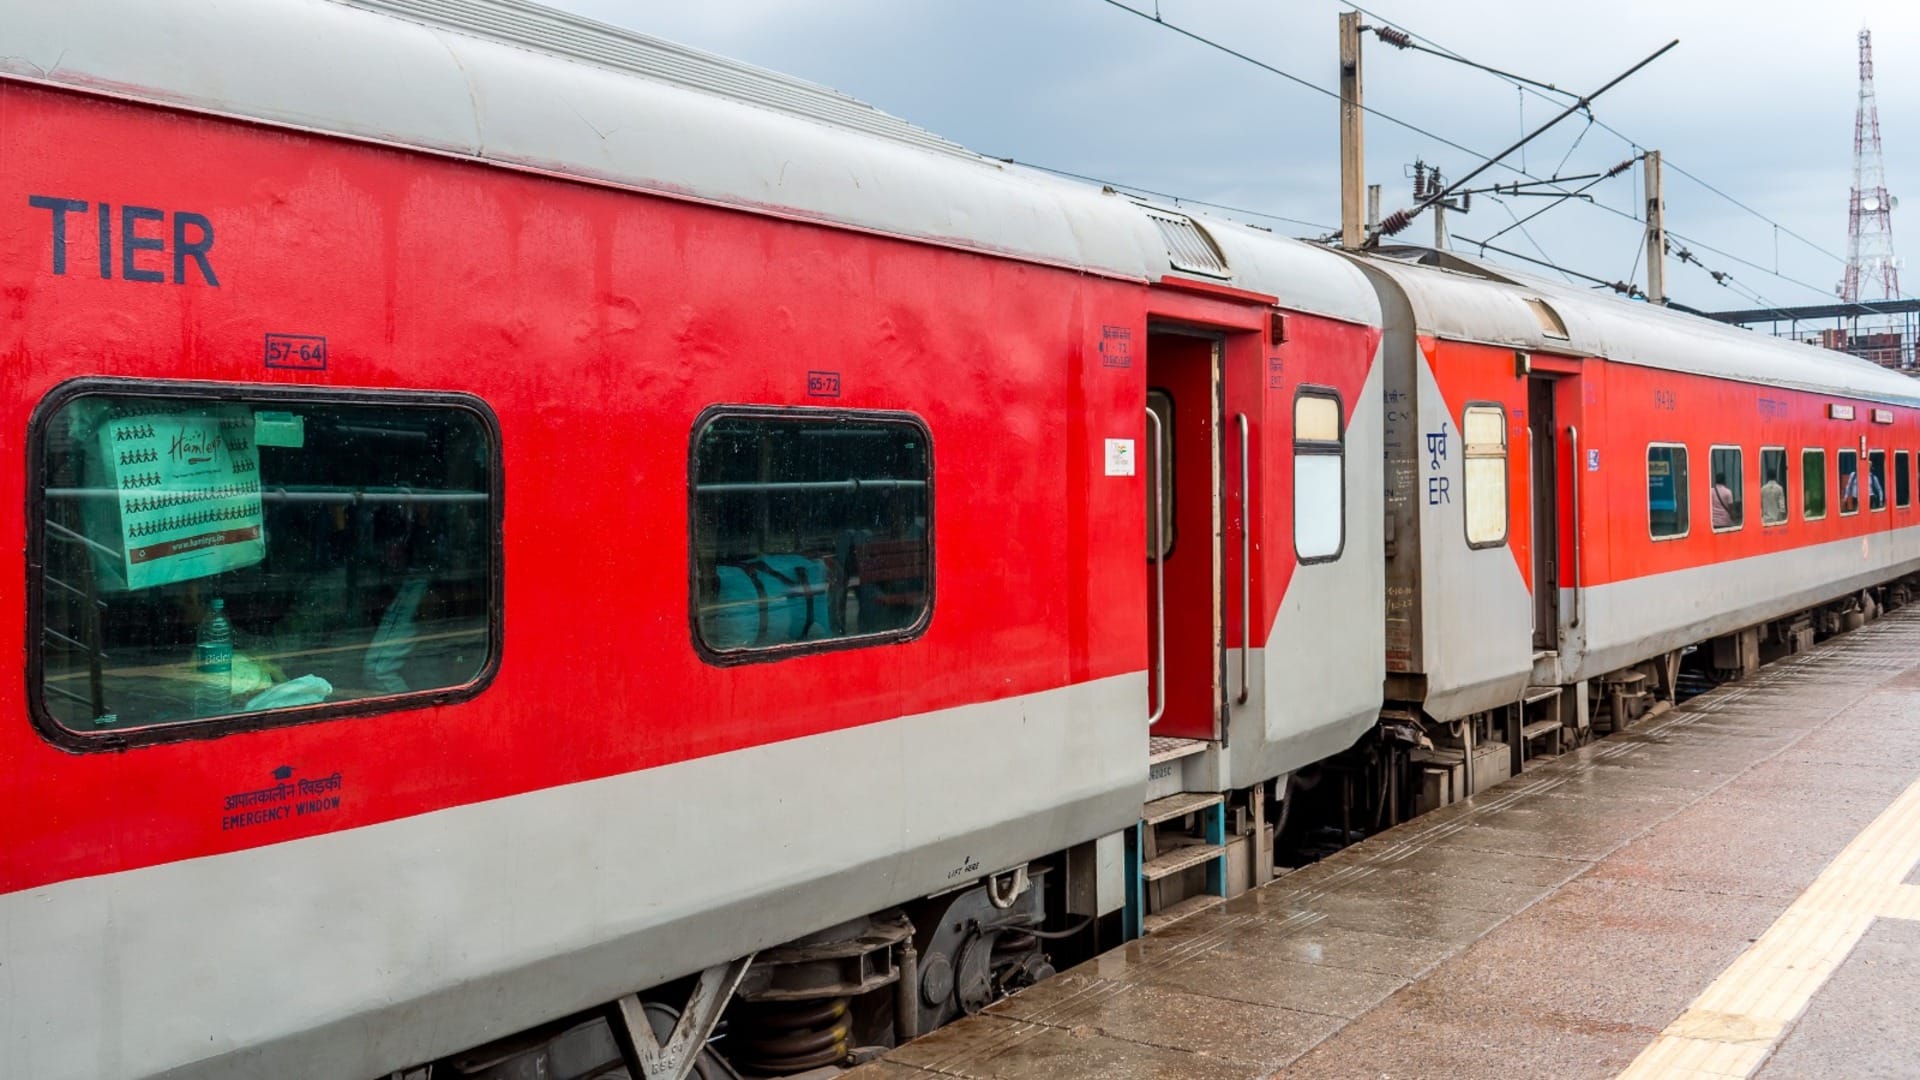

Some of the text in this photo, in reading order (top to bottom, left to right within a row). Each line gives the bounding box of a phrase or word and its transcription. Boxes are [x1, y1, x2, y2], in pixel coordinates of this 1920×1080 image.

[28, 195, 220, 287] TIER
[269, 342, 322, 363] 57-64
[810, 377, 839, 392] 65-72
[1426, 422, 1448, 470] पूर्व
[1428, 476, 1451, 505] ER
[224, 782, 295, 811] आपातकालीन
[222, 796, 340, 831] EMERGENCY WINDOW
